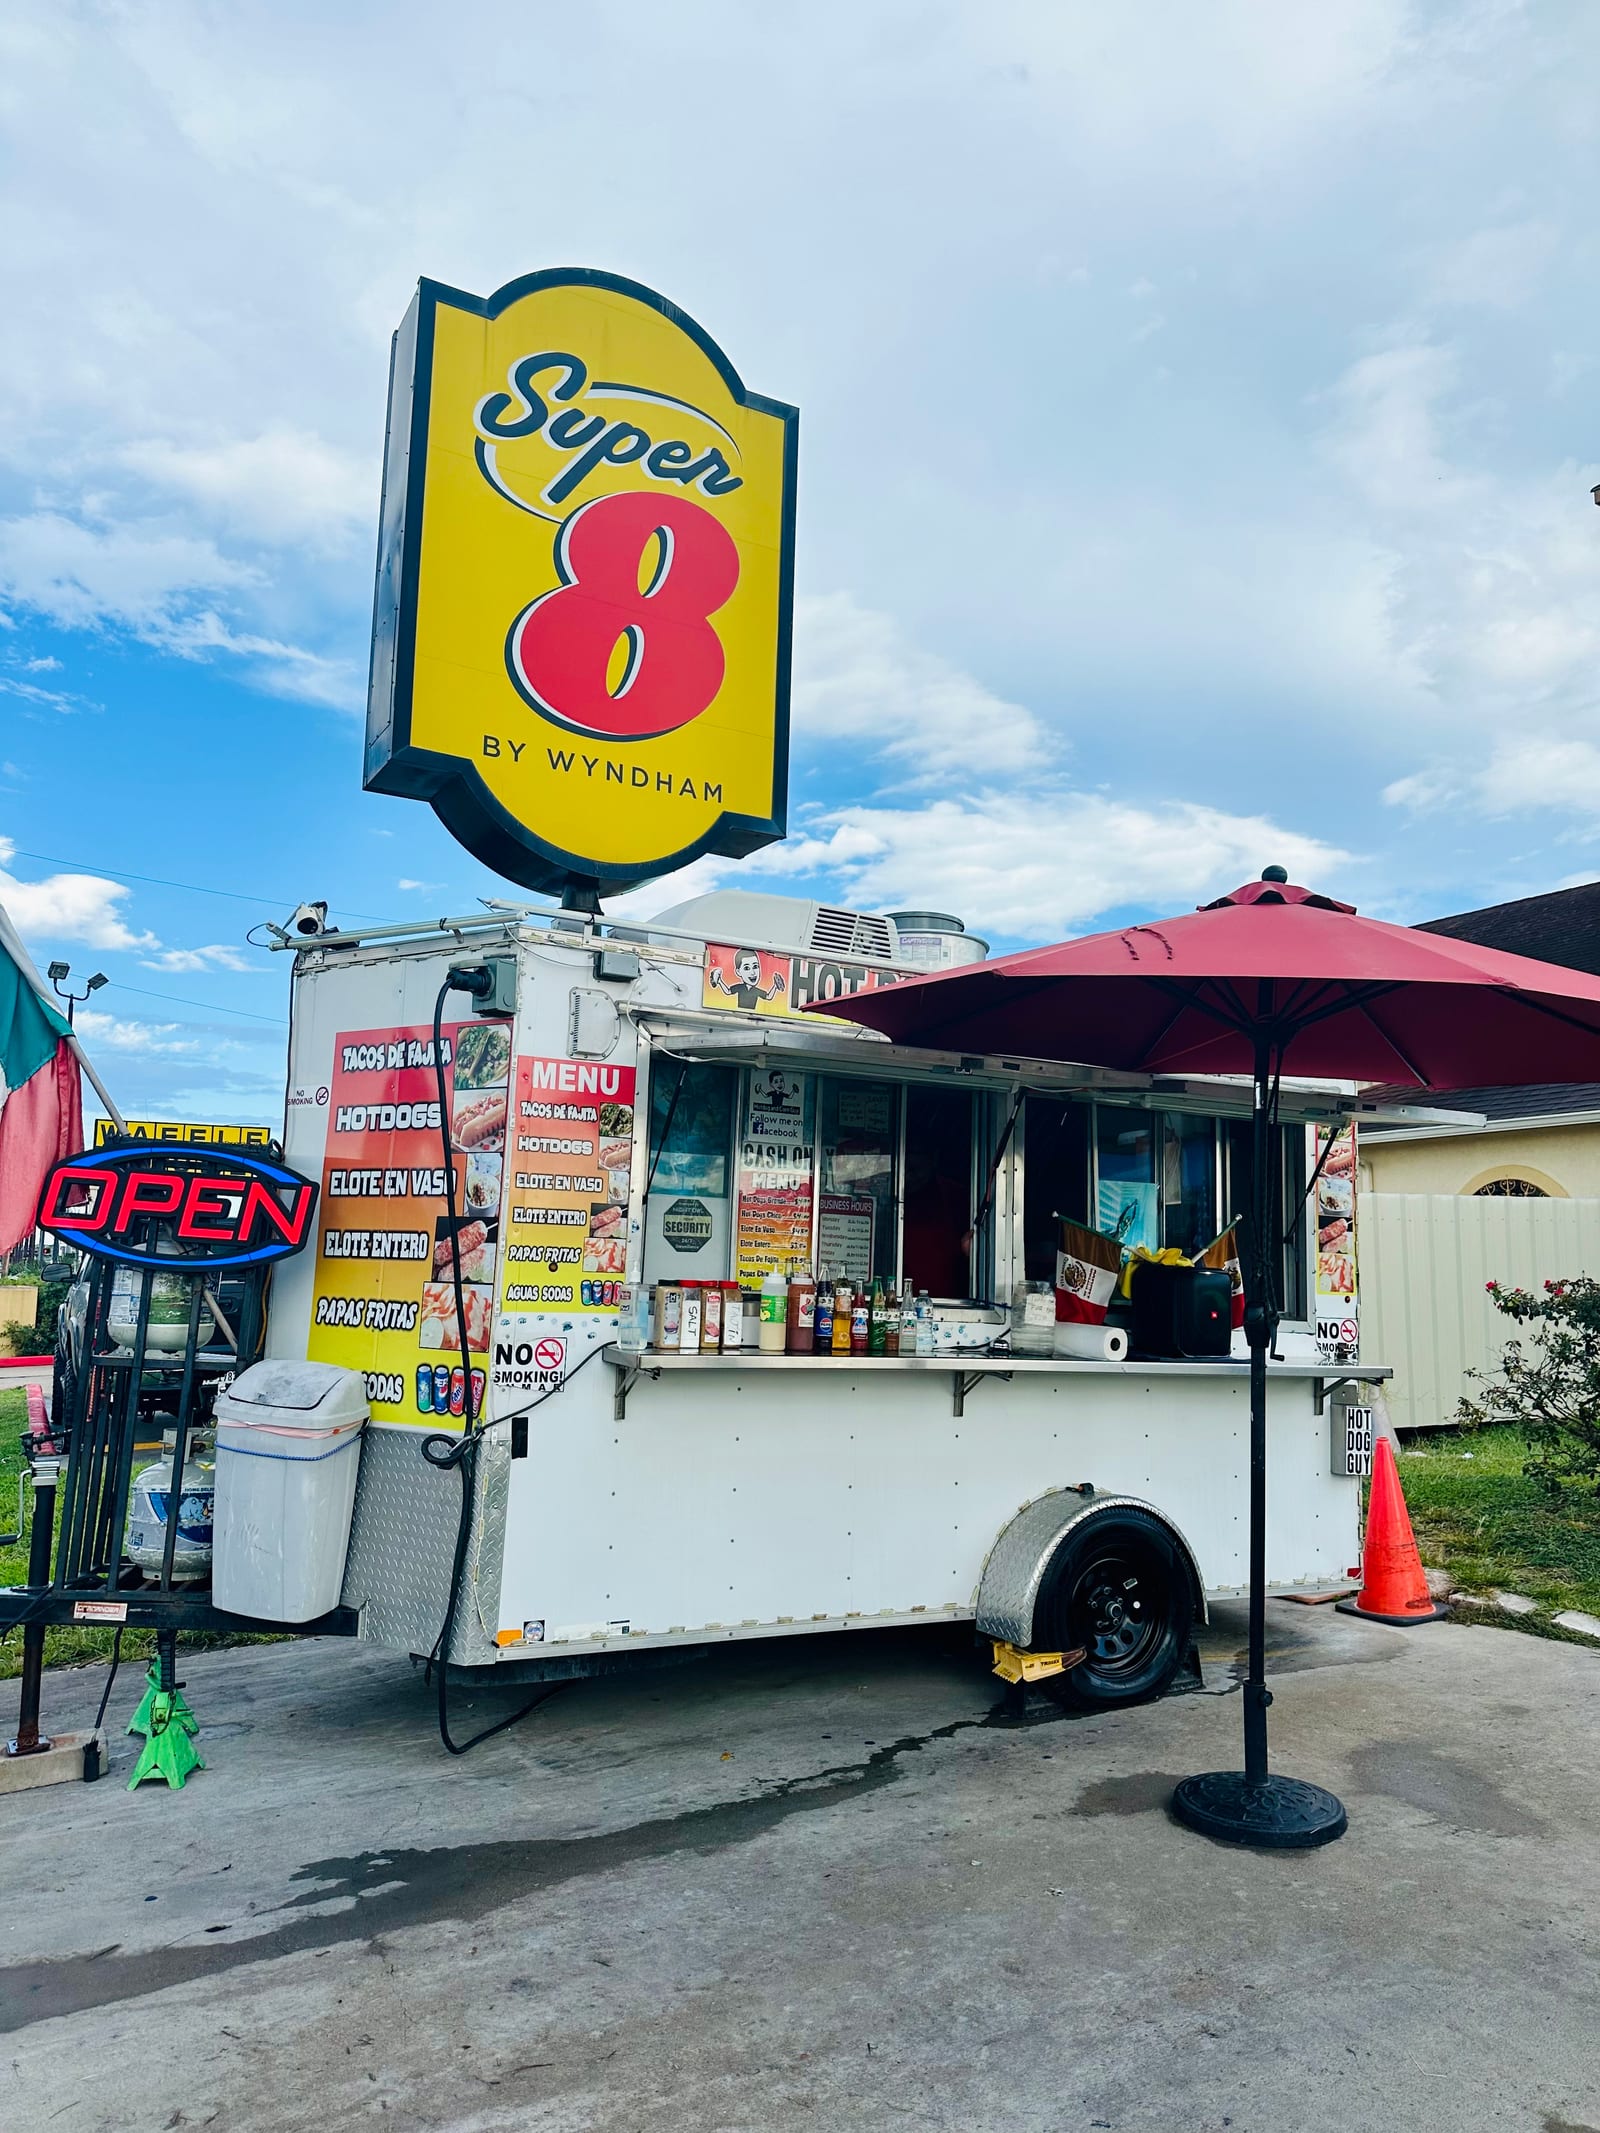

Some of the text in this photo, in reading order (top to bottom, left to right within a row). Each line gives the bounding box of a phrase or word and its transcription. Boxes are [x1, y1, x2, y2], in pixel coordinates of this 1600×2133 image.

[473, 351, 744, 506] Super
[504, 490, 741, 743] 8
[483, 735, 723, 804] BY WYNDHAM
[790, 958, 867, 1009] HOT
[343, 1044, 385, 1072] TACOS
[387, 1041, 406, 1069] DE
[532, 1061, 620, 1096] MENU
[287, 1097, 313, 1106] SMOKING
[521, 1102, 598, 1122] TACOS DE FAJITA
[336, 1103, 442, 1131] HOTDOGS
[750, 1113, 780, 1125] Follow
[780, 1118, 792, 1126] me
[752, 1122, 798, 1138] facebook
[518, 1136, 593, 1155] HOTDOGS
[743, 1143, 835, 1171] CASH ONY
[329, 1170, 382, 1196] ELOTE
[383, 1170, 408, 1196] EN
[516, 1173, 603, 1193] ELOTE EN VASO
[751, 1173, 800, 1191] MENU
[40, 1167, 313, 1245] OPEN
[513, 1207, 587, 1226] ELOTE ENTERO
[820, 1200, 872, 1213] BUSINESS HOURS
[665, 1221, 710, 1234] SECURITY
[324, 1231, 429, 1259] ELOTE ENTERO
[508, 1245, 582, 1263] PAPAS FRITAS
[739, 1270, 756, 1278] Papas
[506, 1285, 573, 1301] AGUAS SODAS
[316, 1298, 418, 1329] PAPAS FRITAS
[688, 1306, 698, 1336] SALT
[1317, 1322, 1340, 1339] NO
[495, 1343, 533, 1365] NO
[493, 1370, 563, 1383] SMOKING!
[1347, 1408, 1371, 1430] HOT
[1347, 1430, 1371, 1452] DOG
[1347, 1453, 1371, 1475] GUY
